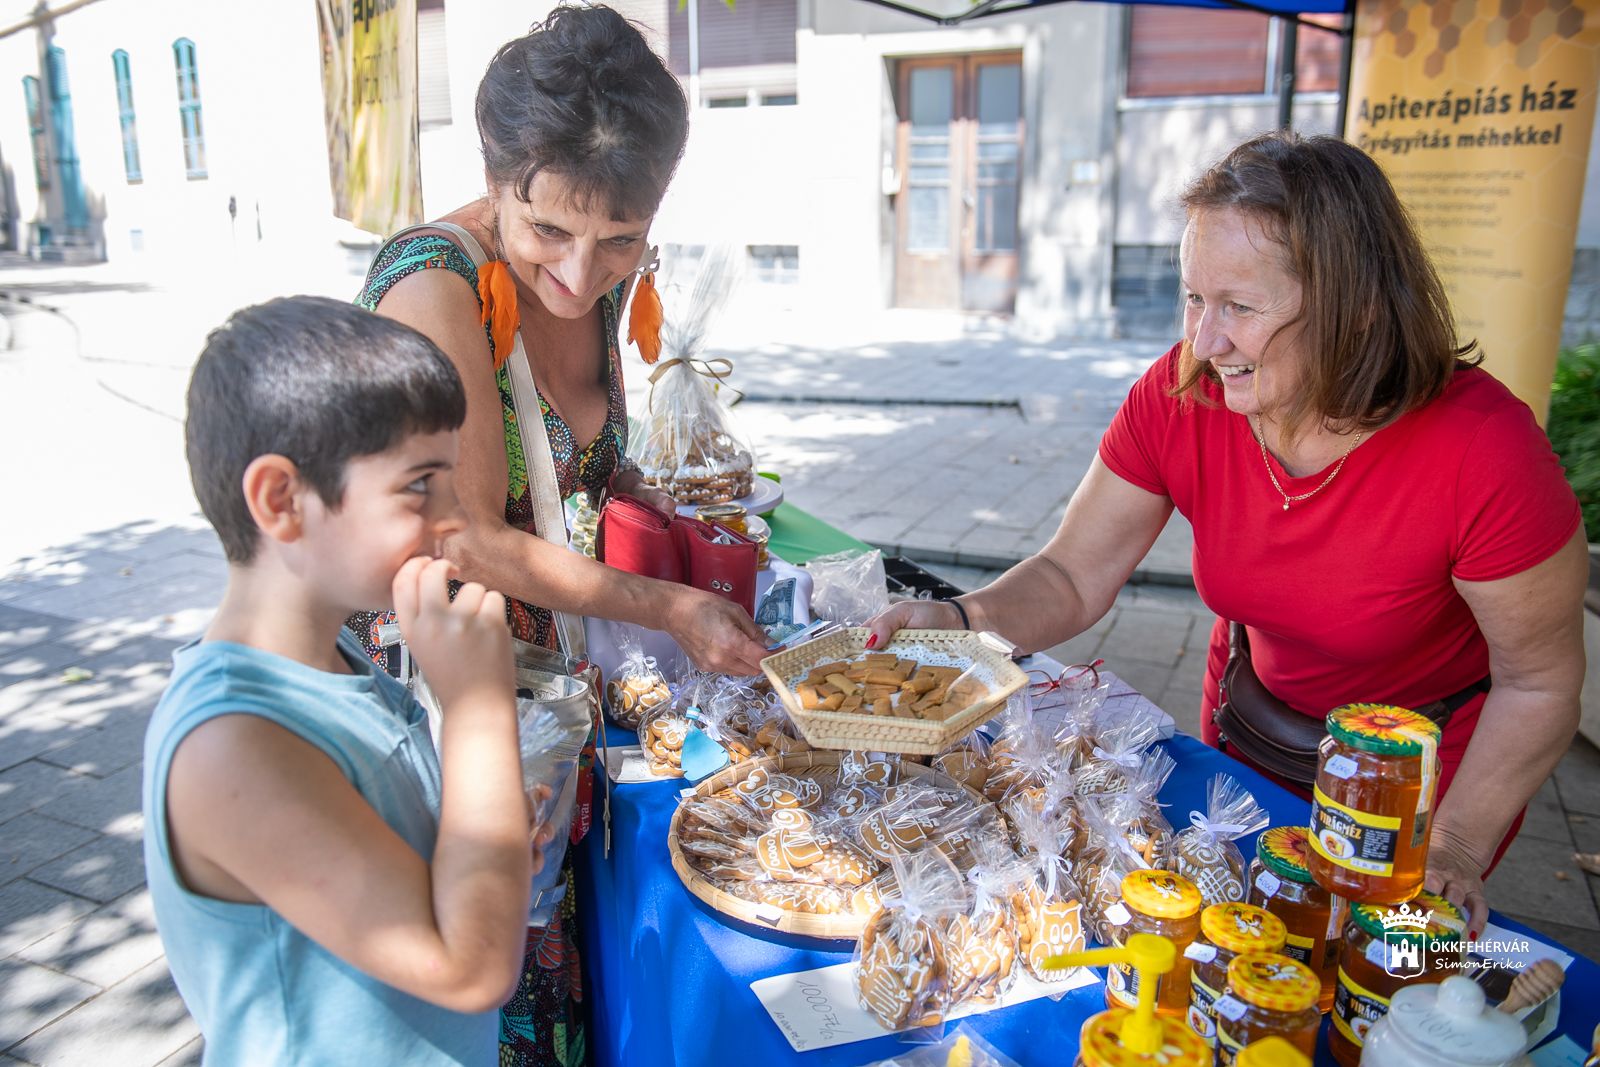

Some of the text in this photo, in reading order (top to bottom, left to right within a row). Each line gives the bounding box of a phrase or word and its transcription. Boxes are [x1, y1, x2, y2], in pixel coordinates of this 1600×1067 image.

[1358, 81, 1577, 127] Apiterápiás ház
[1359, 123, 1562, 154] Gyógyítás méhekkel
[1320, 810, 1362, 840] VIRÁGMÉZ
[796, 980, 833, 1013] 1000
[1350, 998, 1381, 1021] VIRÁG
